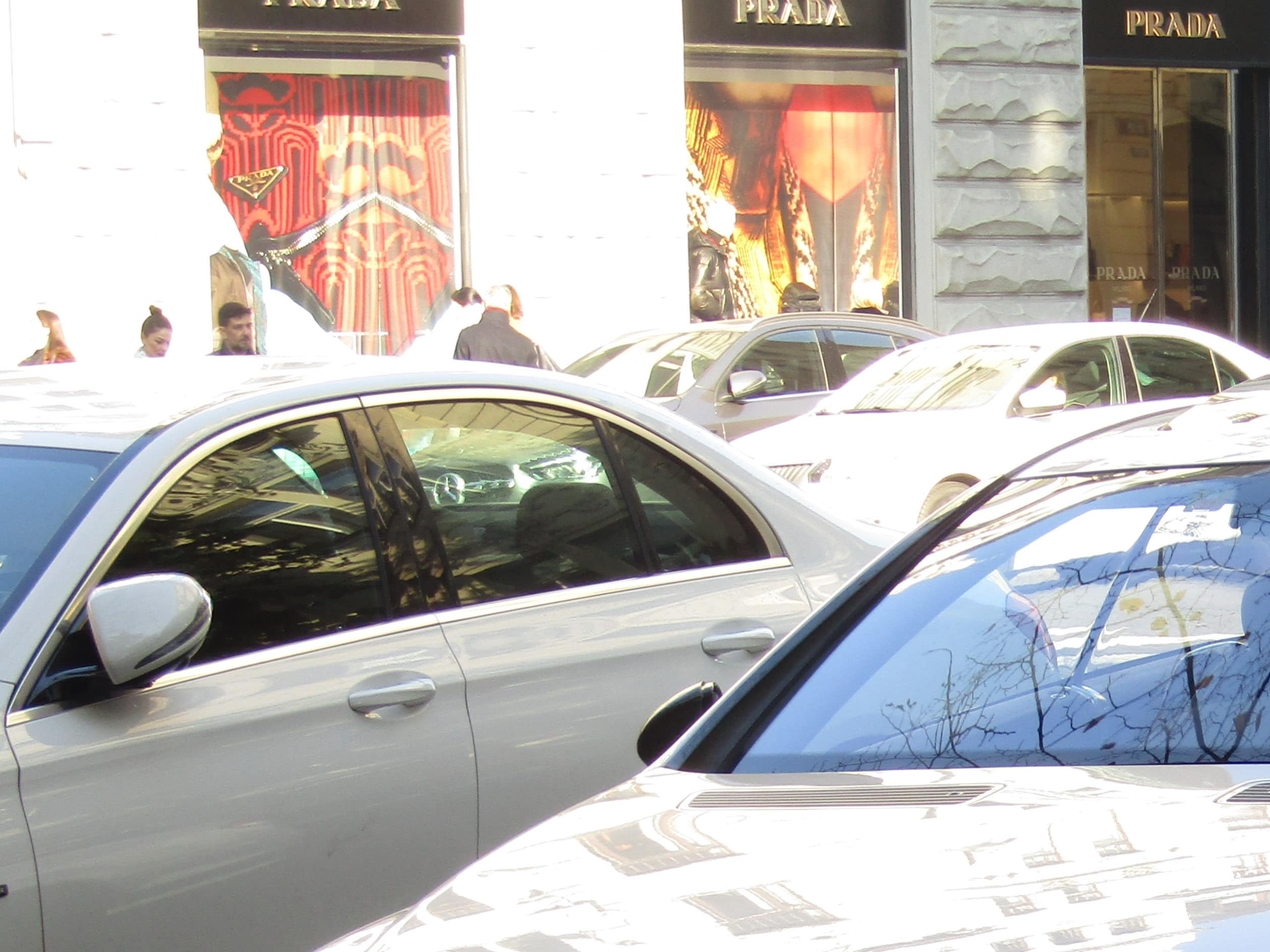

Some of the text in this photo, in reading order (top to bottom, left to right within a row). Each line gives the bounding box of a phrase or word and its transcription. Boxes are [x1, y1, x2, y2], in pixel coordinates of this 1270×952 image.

[735, 0, 852, 27] PRADA
[1125, 10, 1227, 39] PRADA
[1096, 266, 1146, 280] PRADA
[1172, 266, 1220, 280] PRADA
